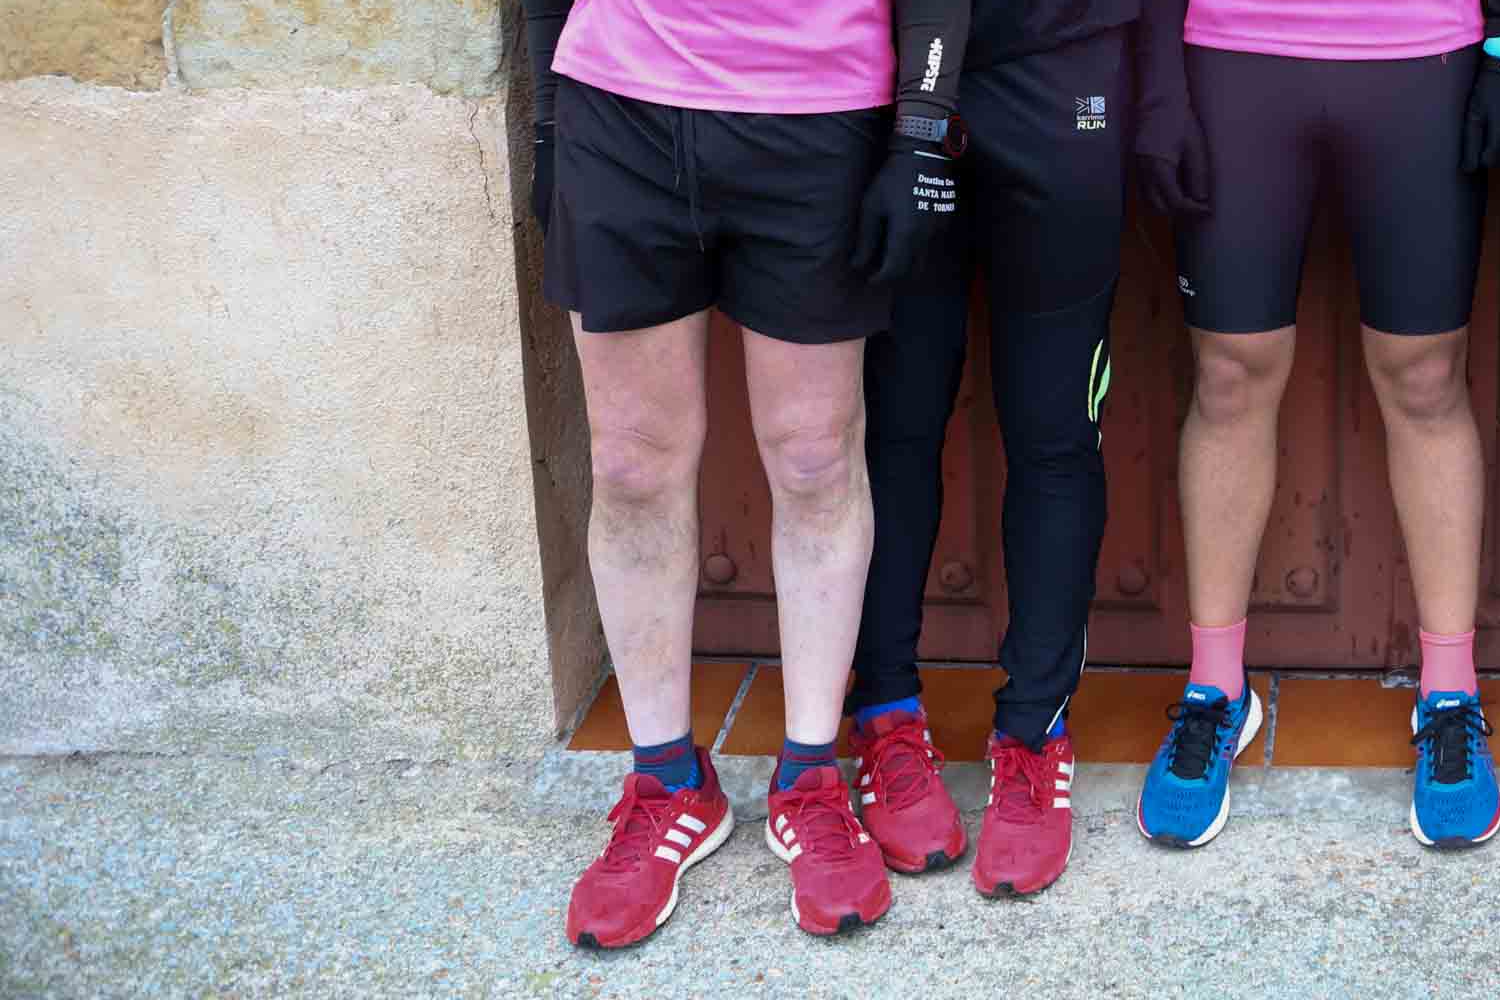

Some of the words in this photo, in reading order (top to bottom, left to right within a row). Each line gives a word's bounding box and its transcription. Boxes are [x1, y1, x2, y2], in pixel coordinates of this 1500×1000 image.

[1077, 120, 1106, 130] RUN
[912, 186, 939, 199] SANTA
[917, 200, 929, 211] DE
